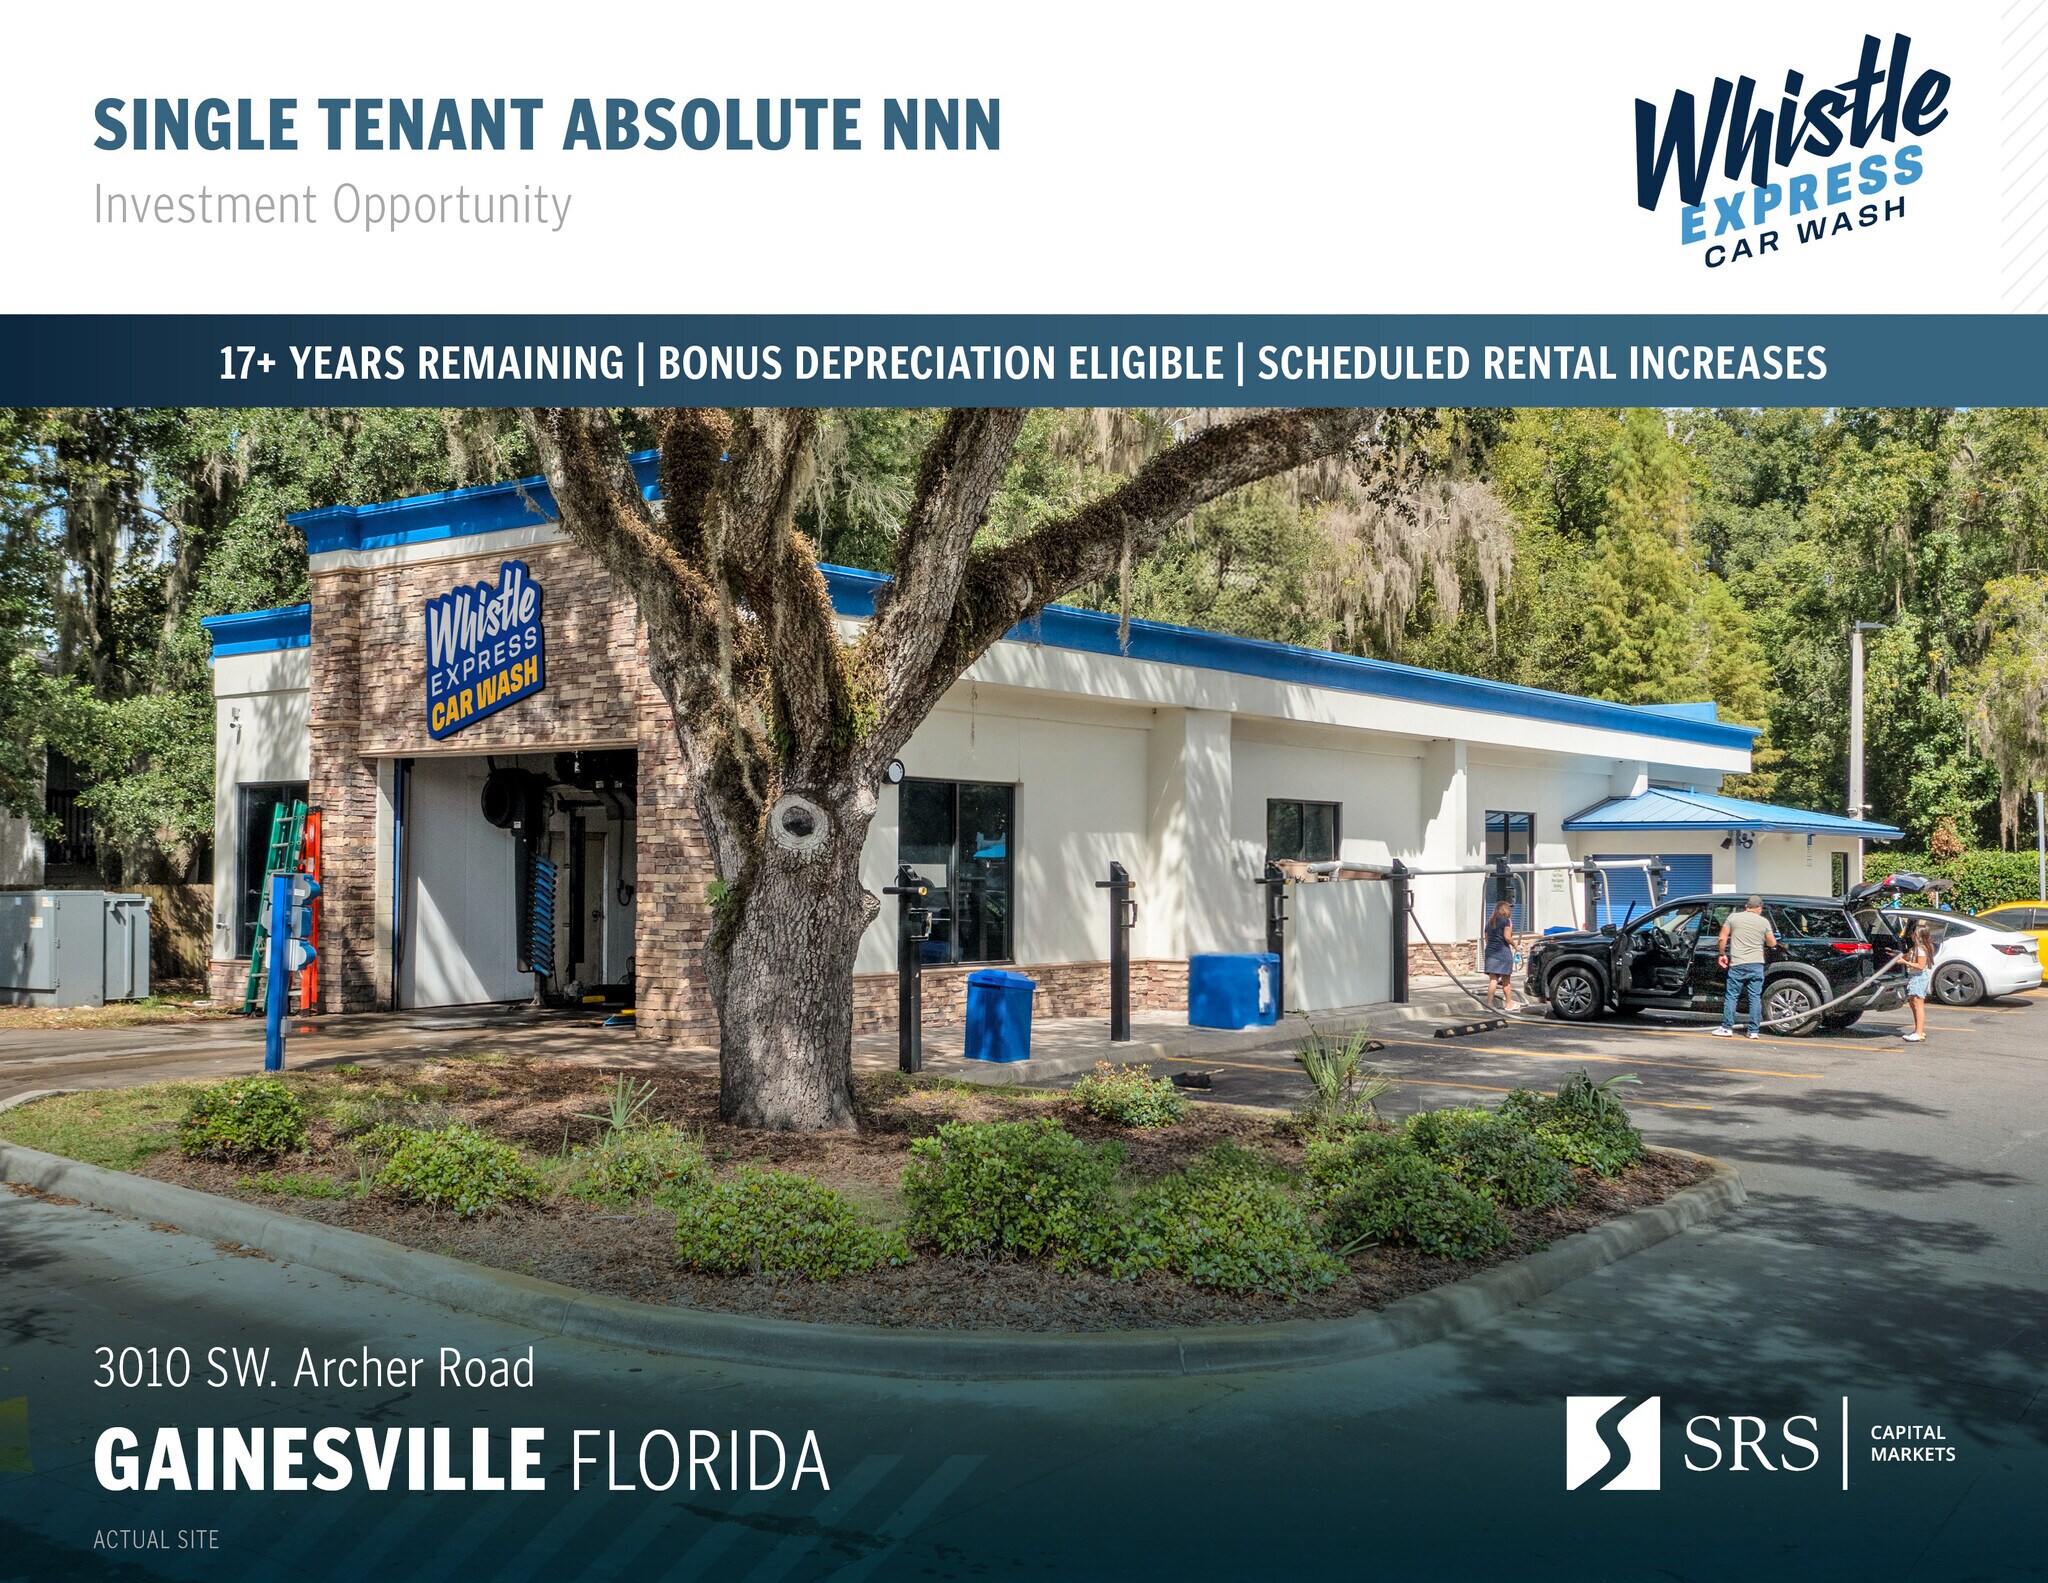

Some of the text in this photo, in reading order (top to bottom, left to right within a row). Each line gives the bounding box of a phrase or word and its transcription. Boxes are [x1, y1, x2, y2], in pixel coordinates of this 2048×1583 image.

[430, 567, 536, 668] Whistle
[431, 626, 537, 697] EXPRESS
[432, 655, 538, 732] CAR WASH
